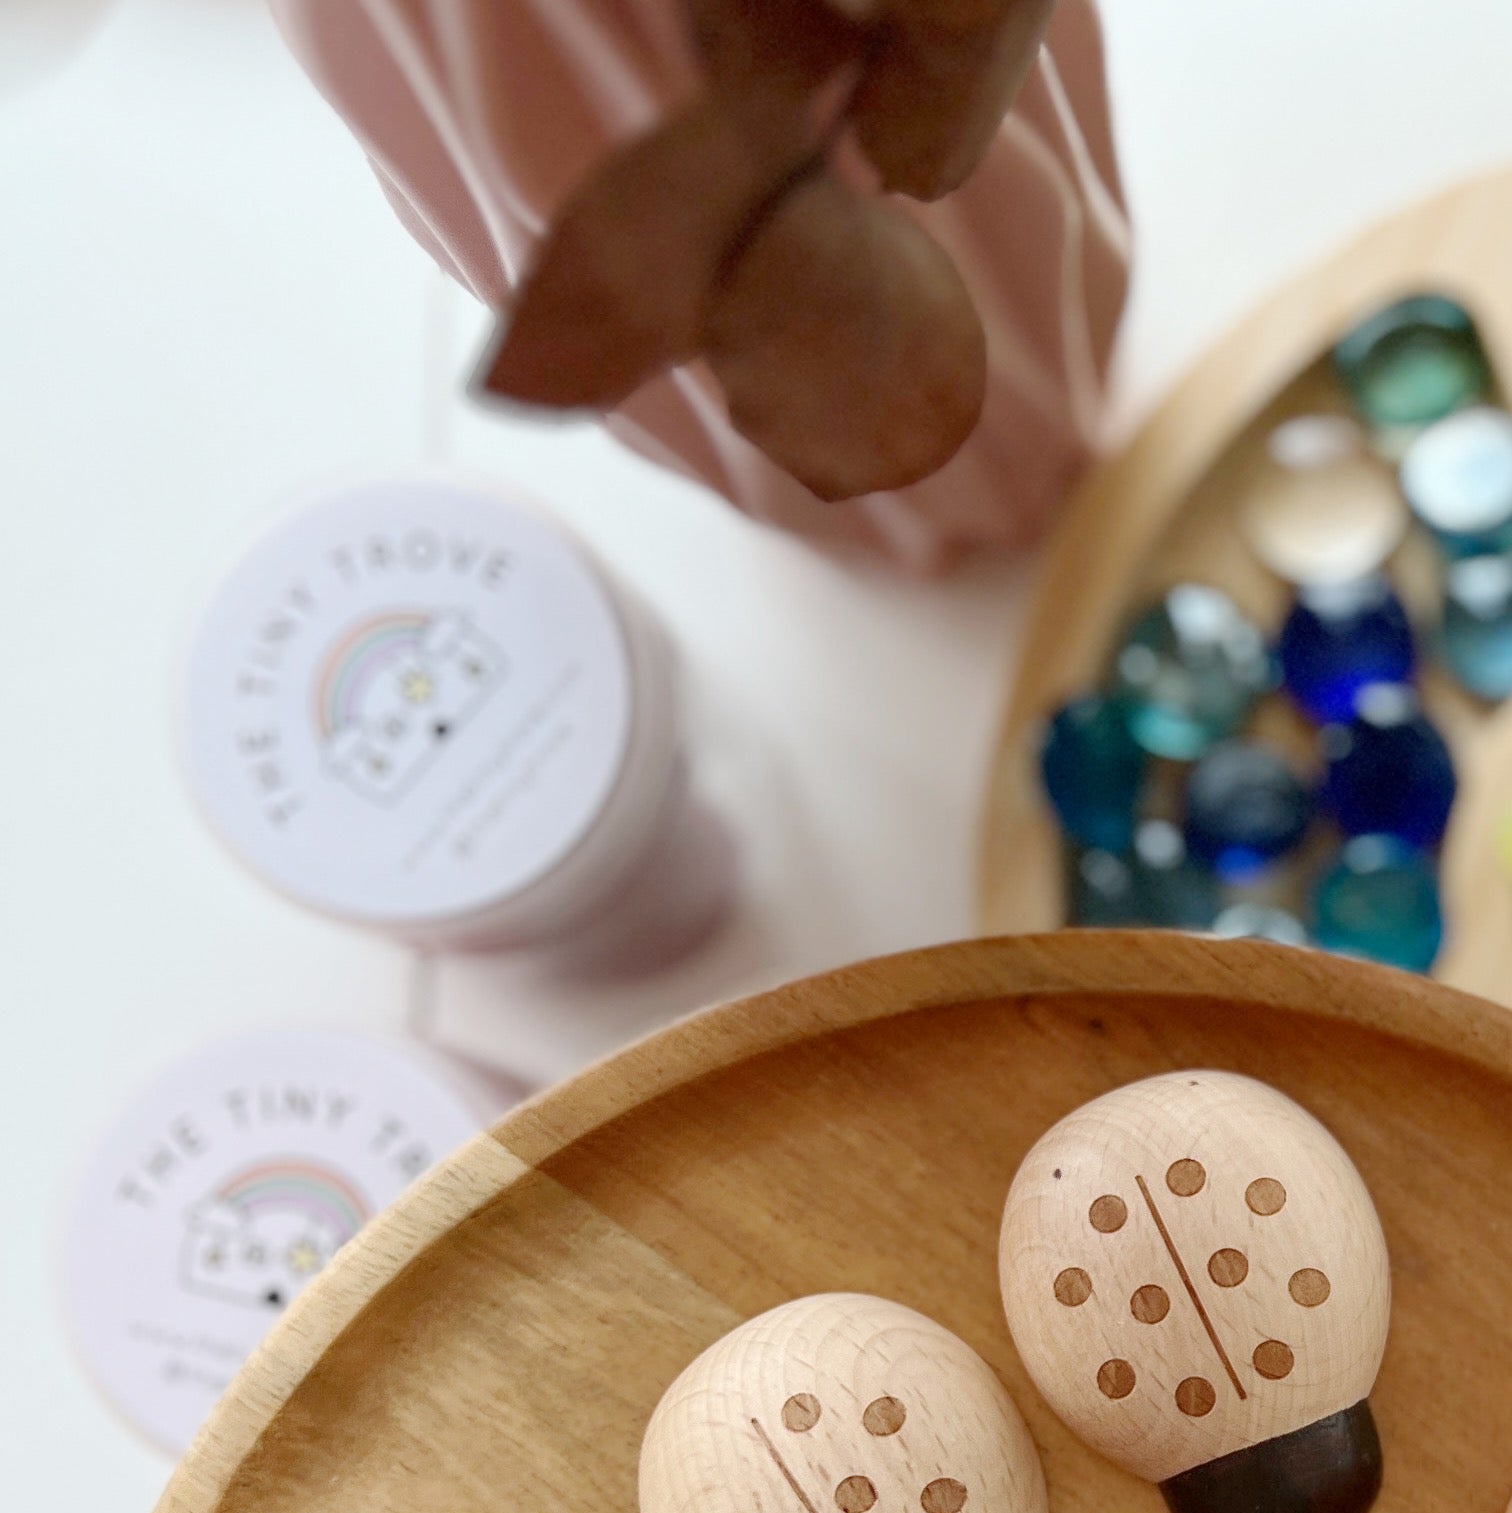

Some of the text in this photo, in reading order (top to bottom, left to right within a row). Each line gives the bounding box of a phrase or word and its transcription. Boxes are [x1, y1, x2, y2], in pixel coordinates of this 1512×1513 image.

[330, 529, 513, 591] TROVE
[237, 580, 314, 697] TINY
[238, 729, 304, 827] THE
[118, 1115, 209, 1206] THE
[224, 1086, 355, 1127] TINY
